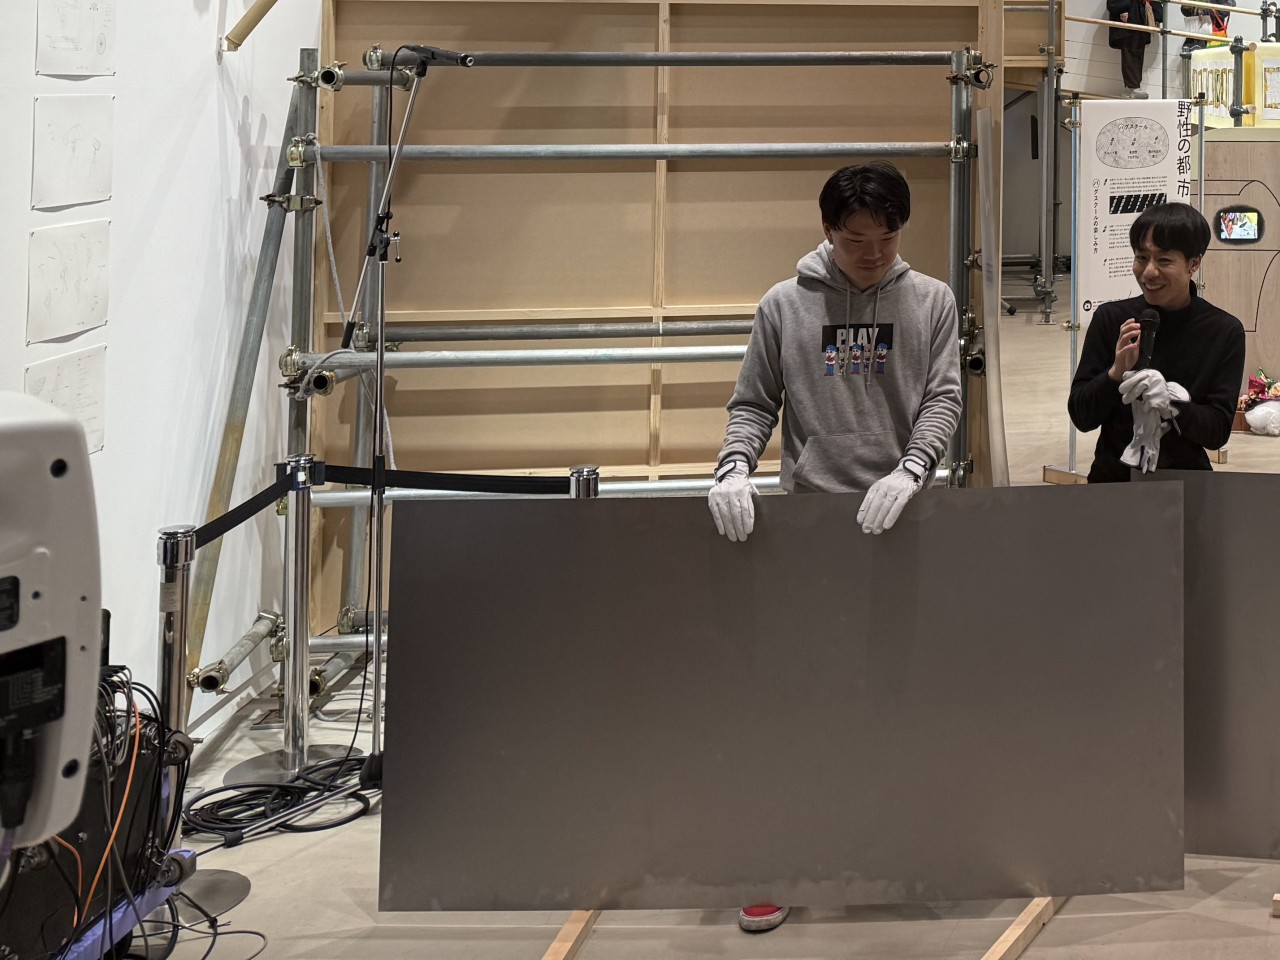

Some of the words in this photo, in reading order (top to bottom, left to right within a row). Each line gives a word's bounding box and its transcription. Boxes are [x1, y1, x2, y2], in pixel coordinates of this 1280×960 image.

[1176, 100, 1191, 198] 野性の都市
[836, 327, 879, 348] PLAY
